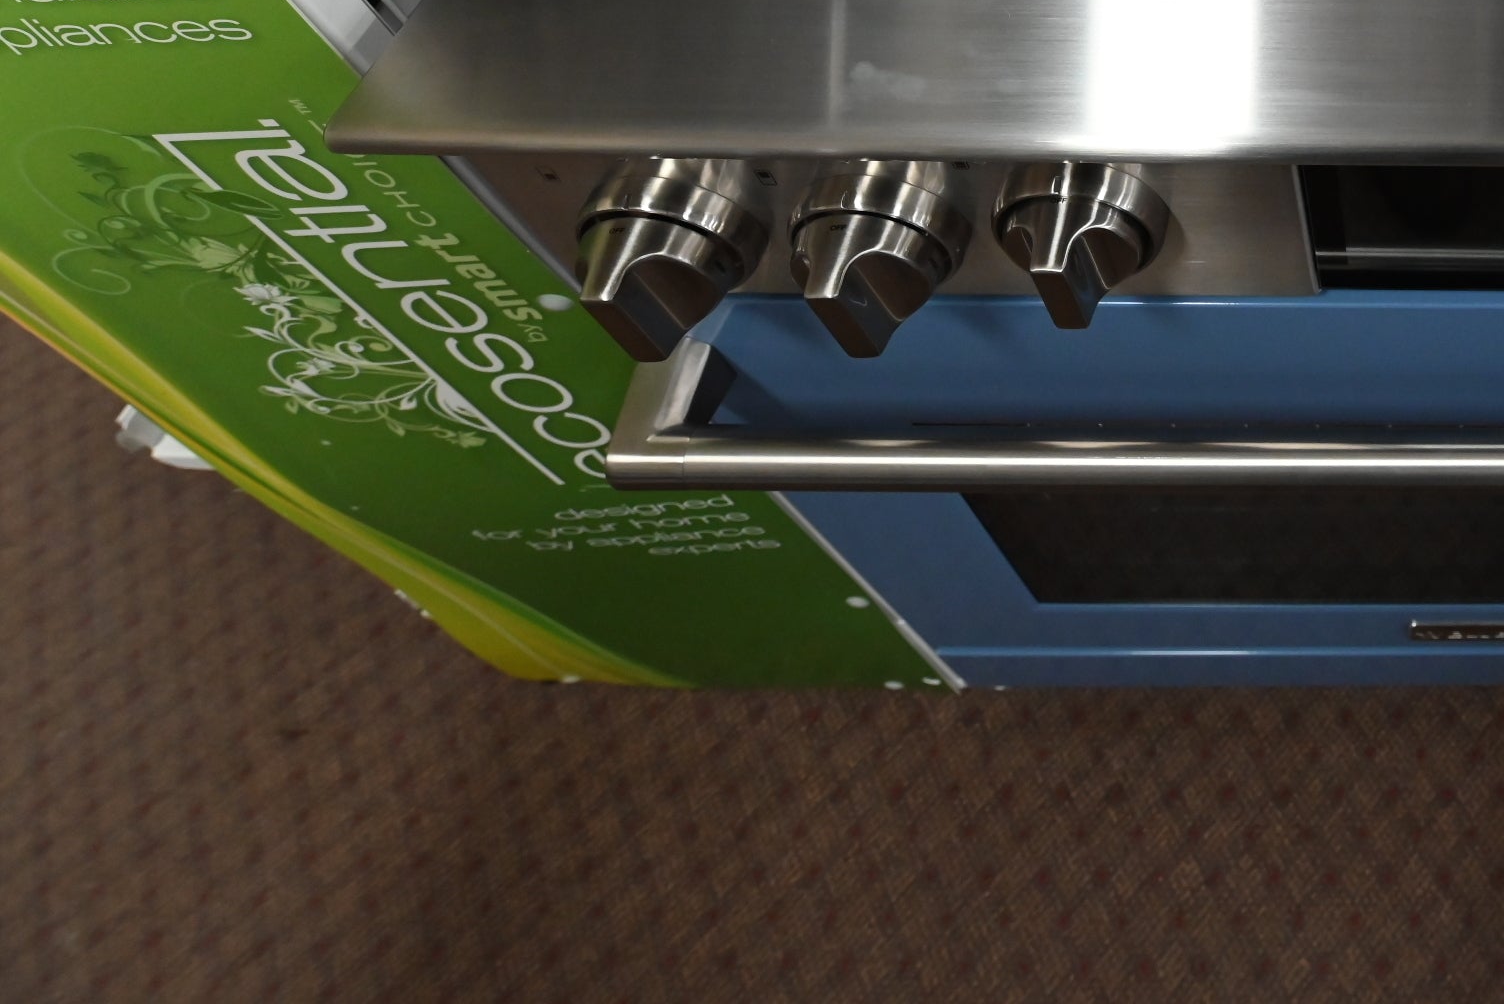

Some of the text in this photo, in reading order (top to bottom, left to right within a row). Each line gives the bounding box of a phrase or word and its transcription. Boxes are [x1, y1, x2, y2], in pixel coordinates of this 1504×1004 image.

[412, 231, 543, 322] smart
[516, 322, 549, 344] by
[554, 494, 735, 520] designed
[472, 511, 750, 541] for your home
[525, 526, 766, 551] by appliance
[648, 539, 781, 556] experts
